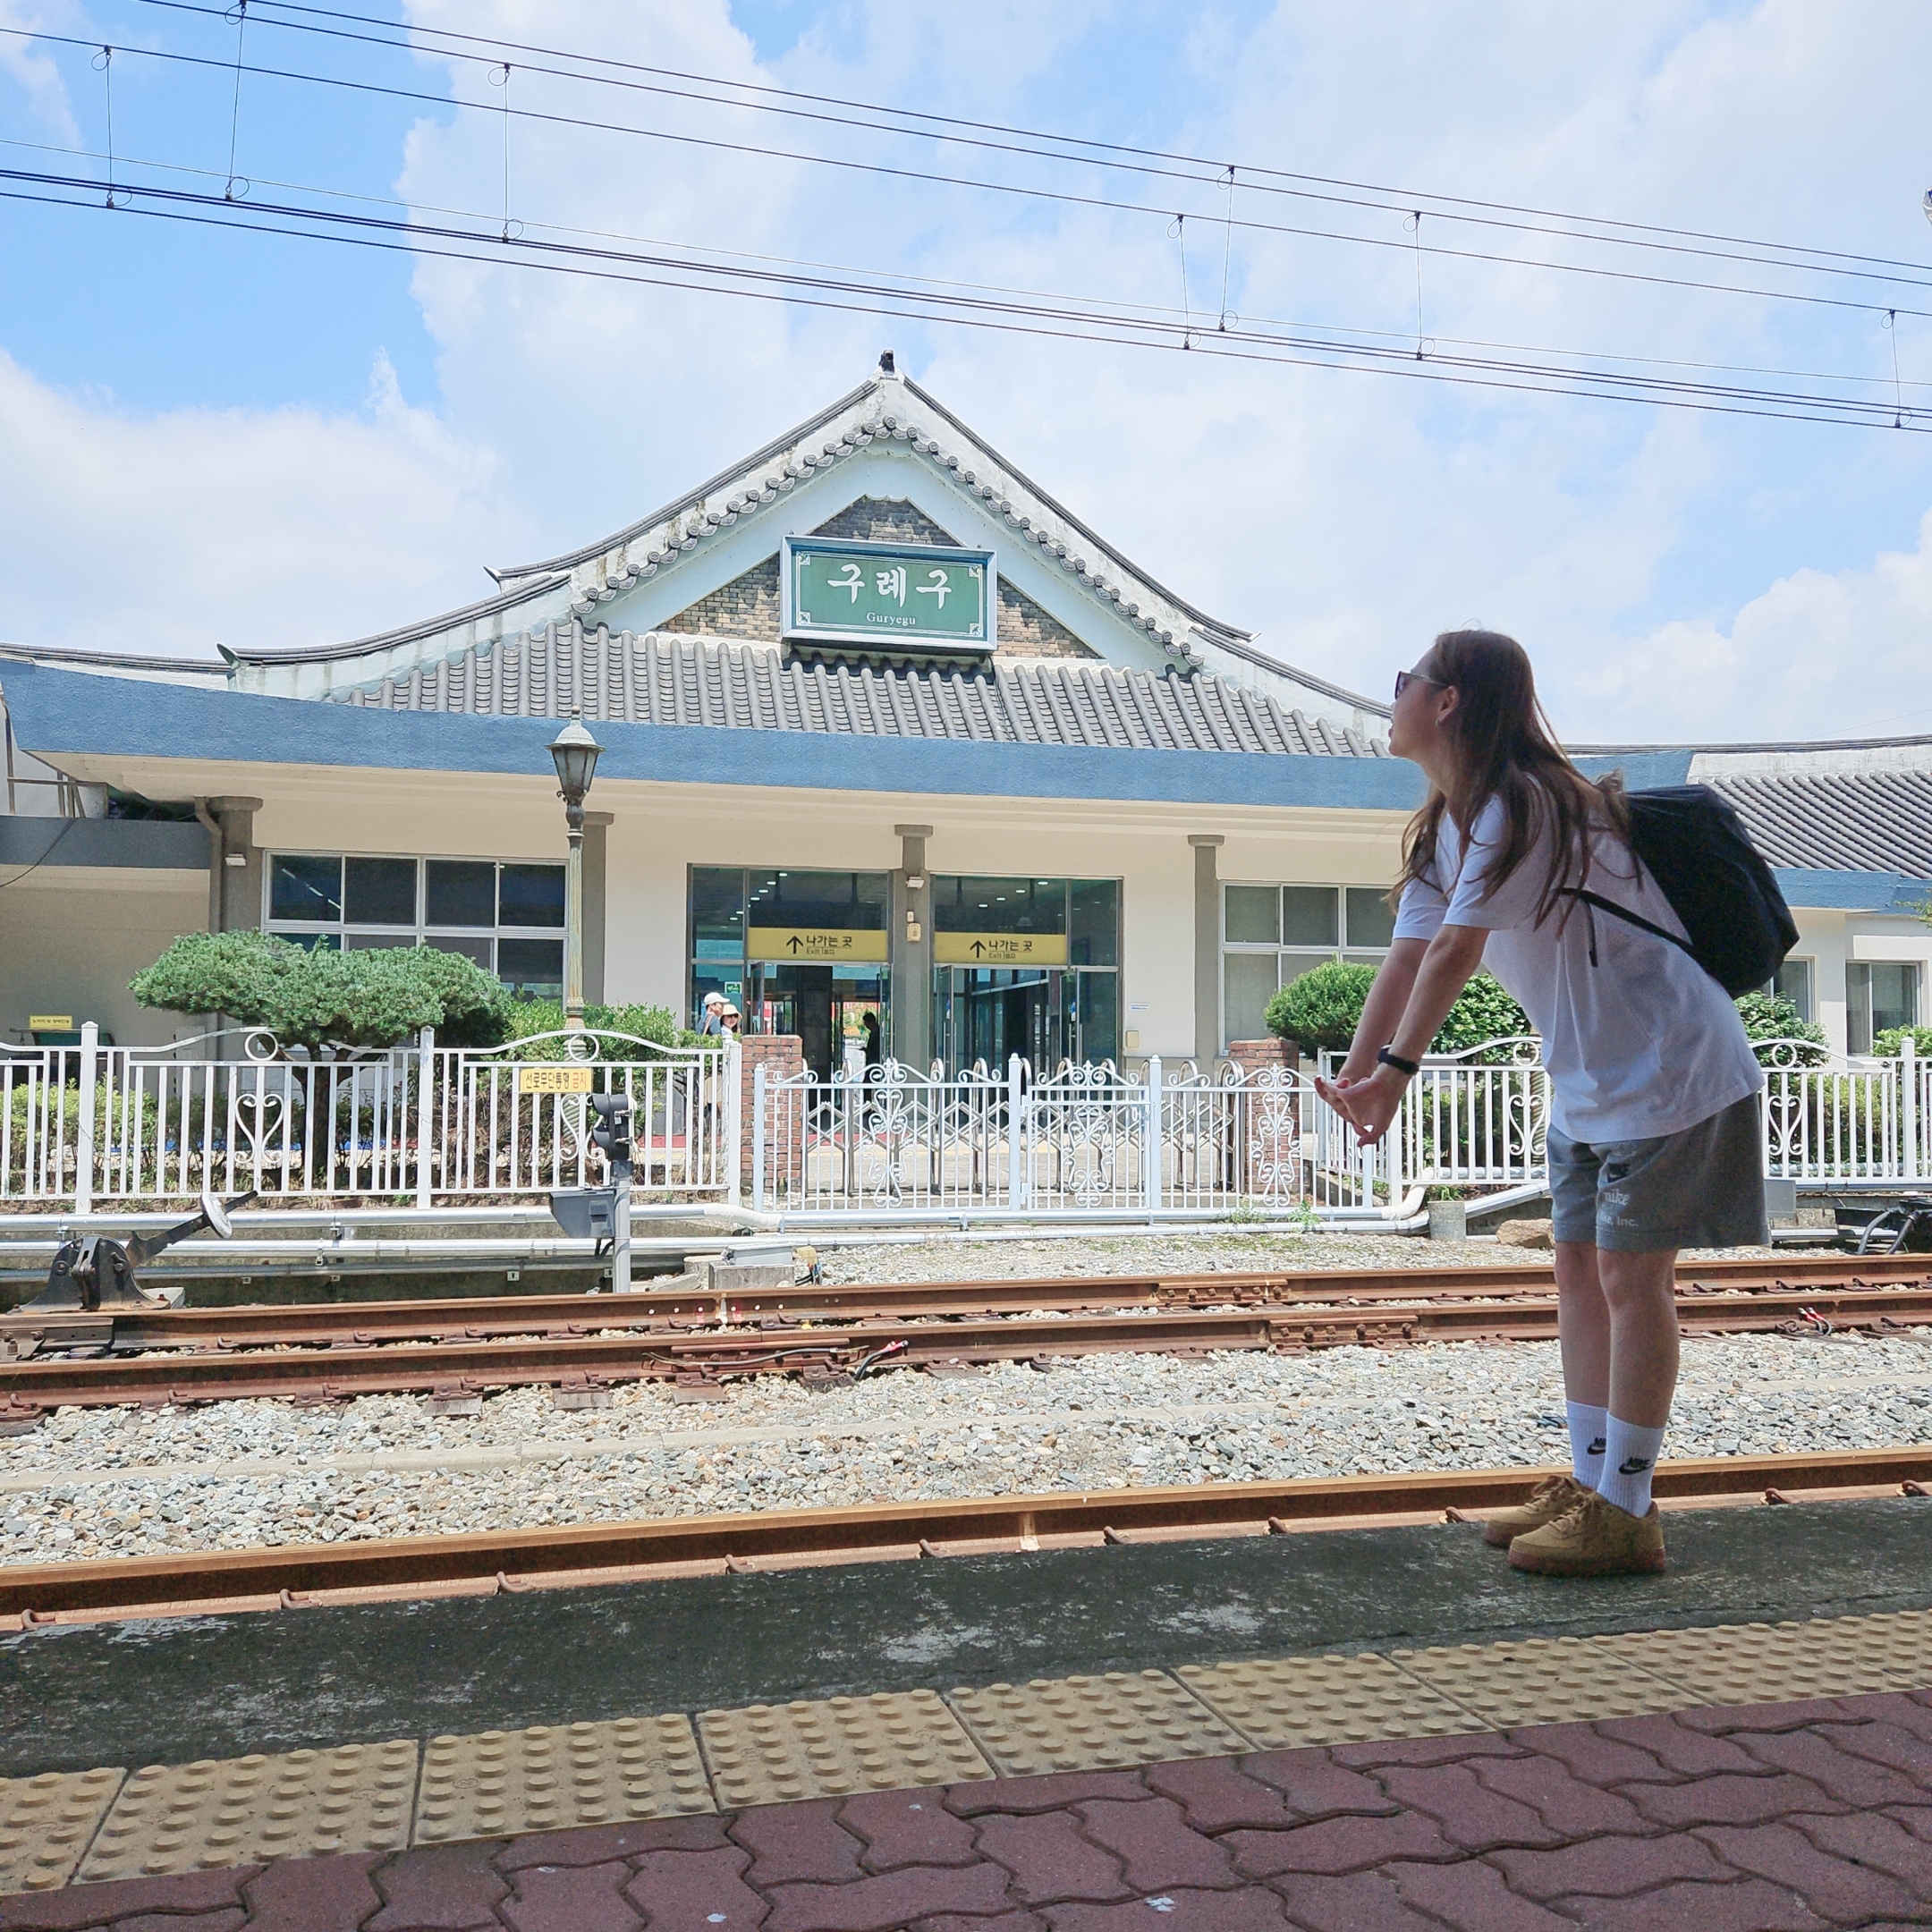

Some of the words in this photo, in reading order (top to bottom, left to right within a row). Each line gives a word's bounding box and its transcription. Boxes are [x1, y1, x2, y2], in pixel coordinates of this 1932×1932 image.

[827, 564, 952, 609] 구례구
[866, 612, 917, 626] Guryegu
[806, 935, 838, 947] 나가는
[842, 936, 852, 947] 곳
[988, 939, 1020, 952] 나가는
[1022, 940, 1033, 952] 곳
[988, 952, 1003, 960] Exit
[526, 1072, 569, 1089] 선로무단통행
[572, 1072, 587, 1089] 금지
[1604, 1189, 1630, 1206] nike
[1616, 1216, 1639, 1227] Inc.
[1626, 1456, 1651, 1470] NIKE
